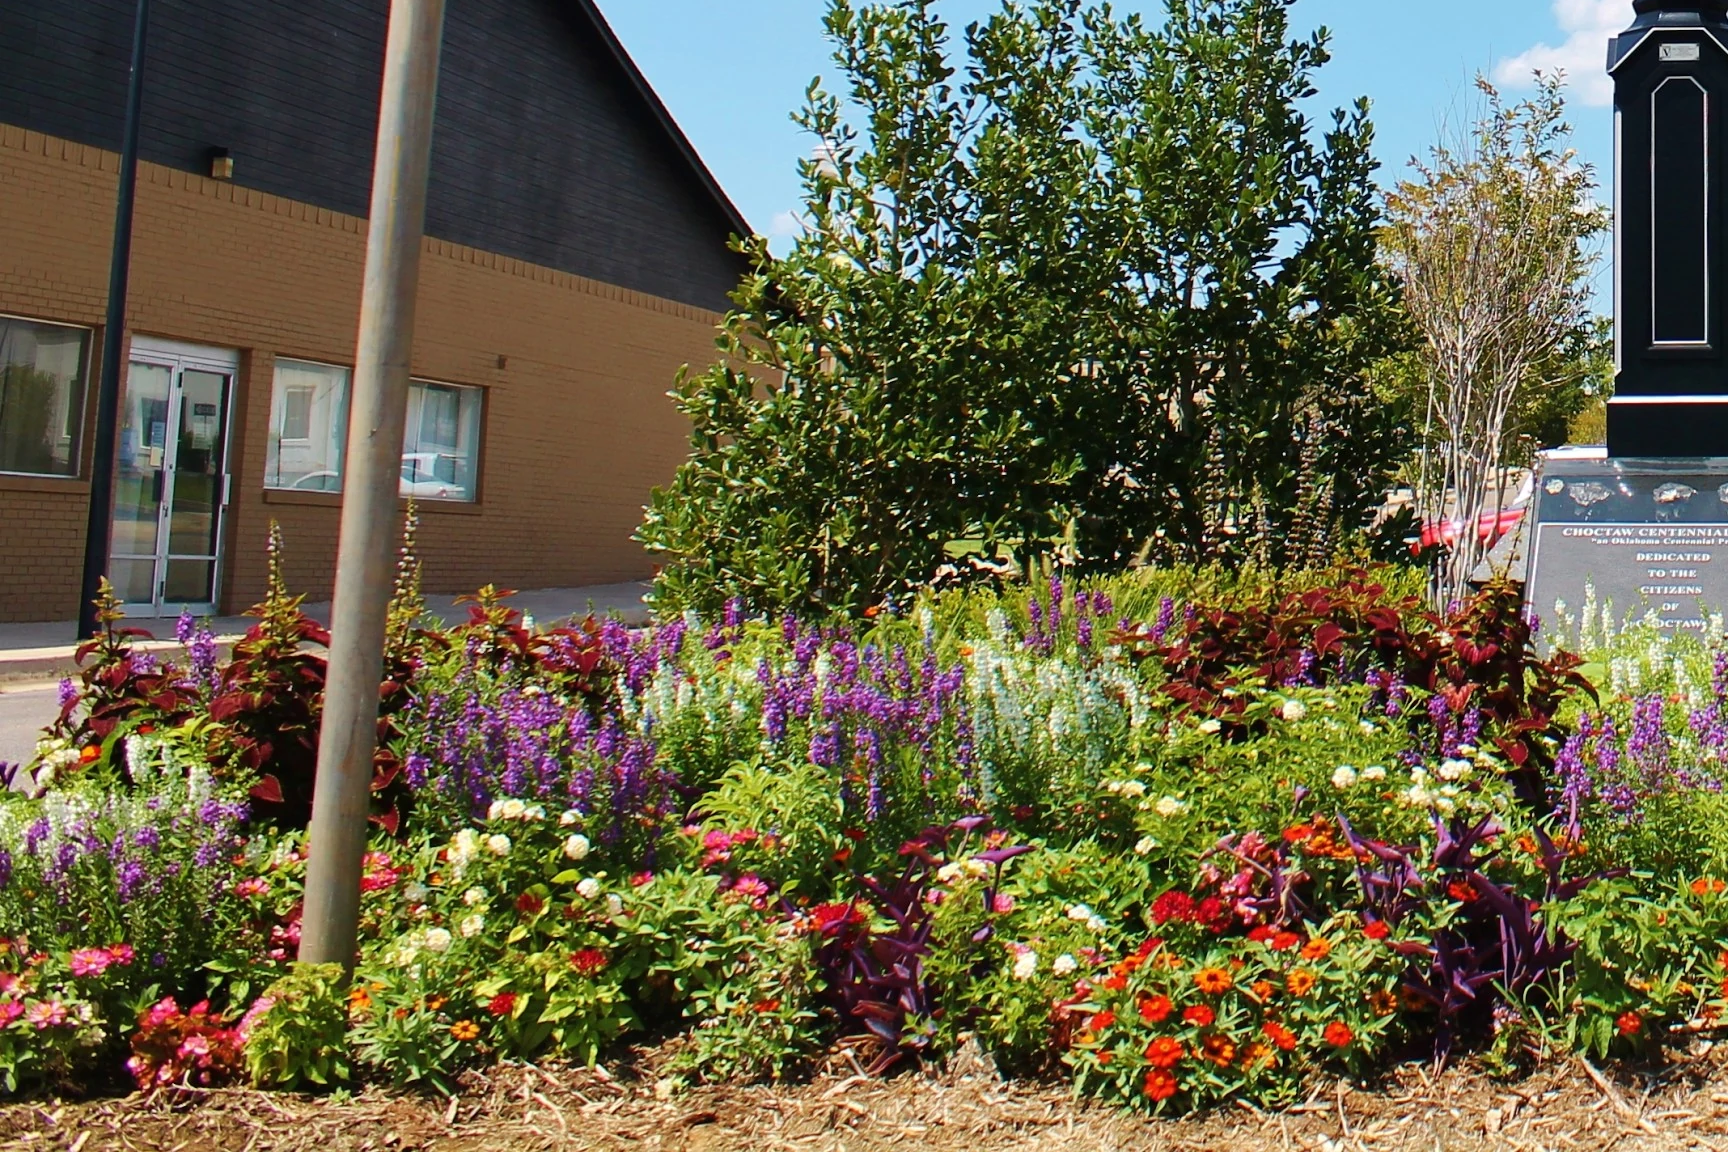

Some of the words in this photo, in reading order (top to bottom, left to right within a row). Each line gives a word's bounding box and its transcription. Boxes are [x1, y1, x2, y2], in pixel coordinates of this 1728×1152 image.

[1562, 527, 1634, 537] CHOCTAW
[1611, 537, 1660, 545] Oklahoma
[1663, 537, 1714, 545] Centennial
[1636, 553, 1711, 562] DEDICATED
[1647, 569, 1666, 578] TO
[1670, 569, 1697, 578] THE
[1640, 586, 1703, 595] CITIZENS
[1662, 602, 1680, 611] OF
[1635, 619, 1703, 628] COCTAW
